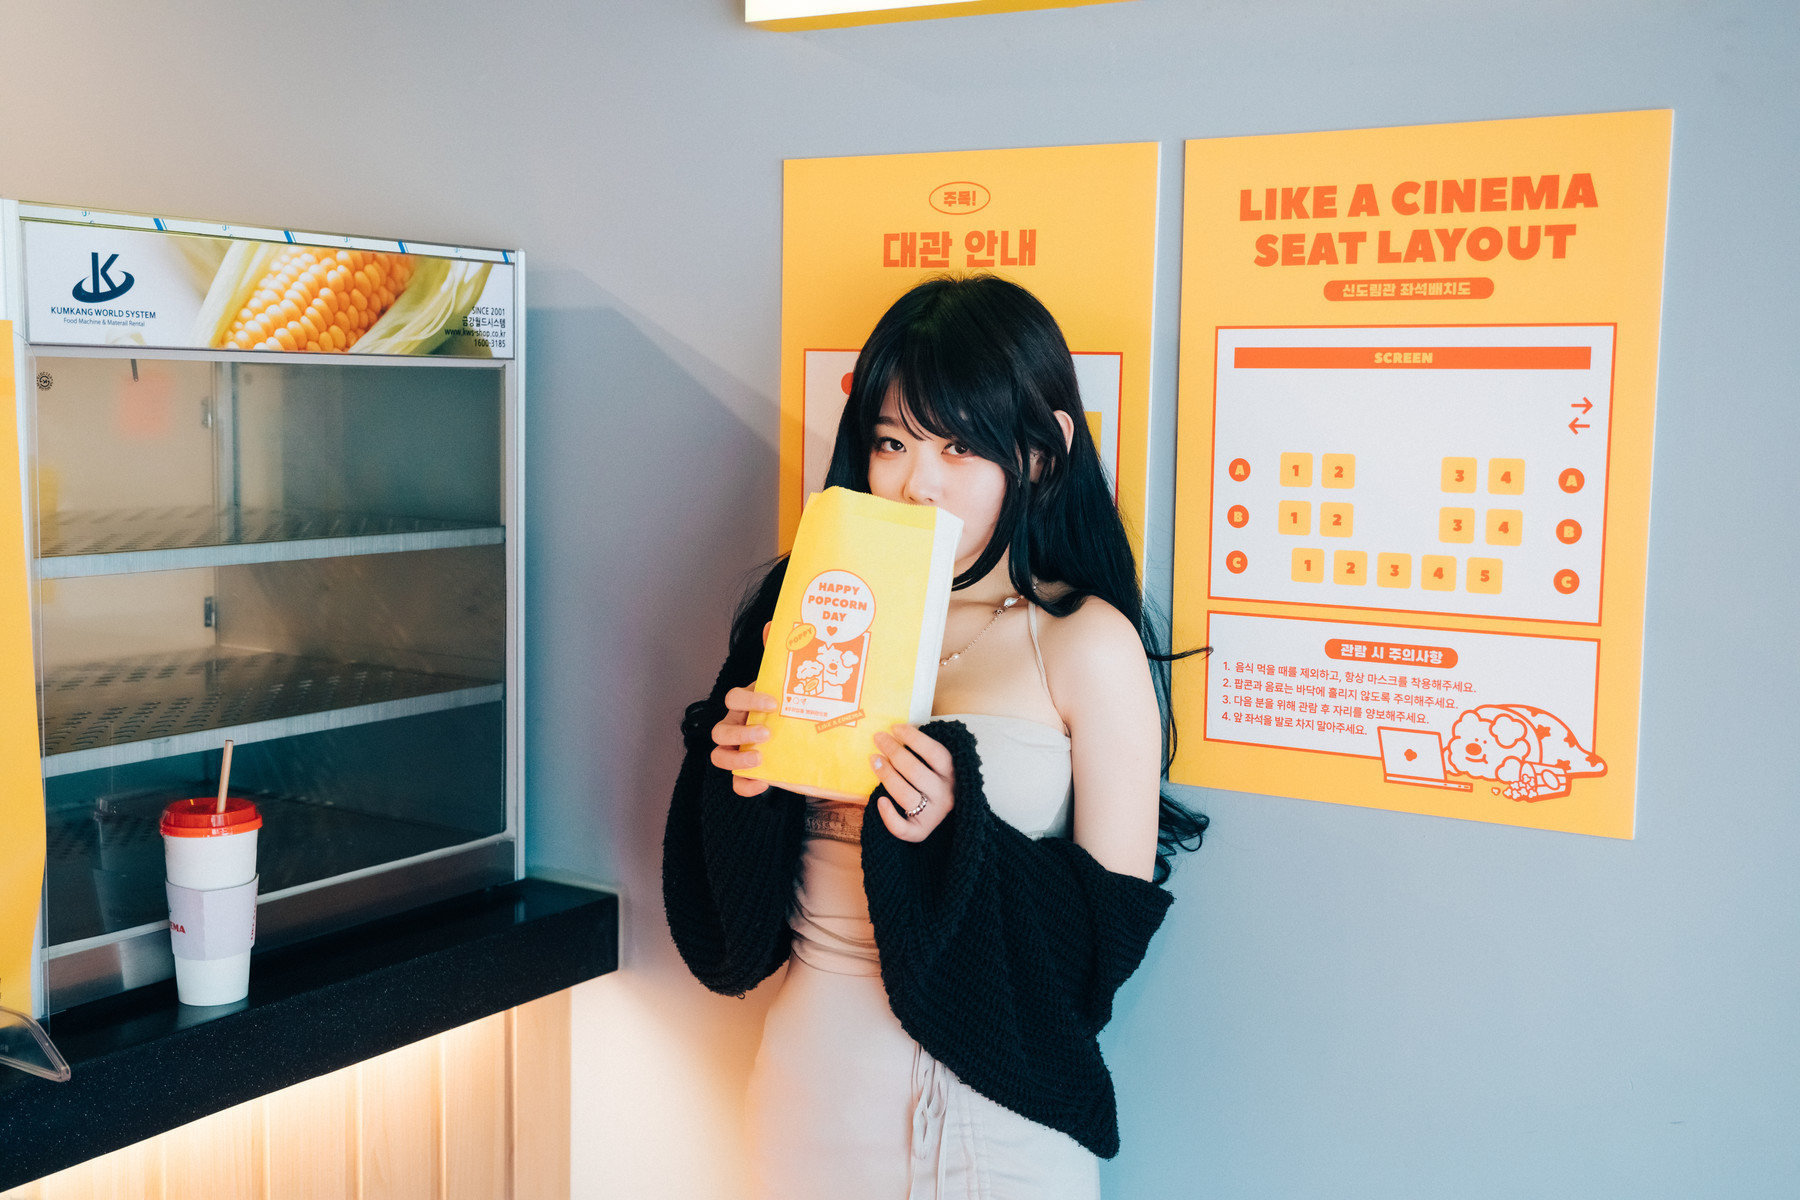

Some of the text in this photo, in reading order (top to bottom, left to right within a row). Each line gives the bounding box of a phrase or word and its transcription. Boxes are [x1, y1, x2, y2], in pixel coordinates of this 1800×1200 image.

[943, 190, 977, 207] 주목!
[1239, 172, 1600, 222] LIKE A CINEMA
[883, 229, 1037, 268] 대관 안내
[1253, 224, 1577, 267] SEAT LAYOUT
[1342, 281, 1471, 298] 신도림관 좌석배치도
[50, 306, 156, 319] KUMKANG WORLD SYSTEM
[472, 306, 505, 316] SINCE 2001
[462, 315, 506, 328] 금강월드시스템
[474, 338, 506, 348] 1600-3185
[1374, 352, 1433, 364] SCREEN
[1235, 464, 1578, 487] A 1 2 3 4 A
[1233, 511, 1575, 538] B 1 2 3 4 B
[1232, 557, 1572, 588] C 1 2 3 4 5 C
[818, 582, 860, 596] HAPPY
[807, 595, 868, 611] POPCORN
[822, 610, 847, 622] DAY
[788, 627, 813, 647] POPPY
[1341, 643, 1443, 664] 관람 시 주의사항
[1223, 661, 1476, 693] 1. 음식 먹을 때를 제외하고, 항상 마스크를 착용해주세요.
[1222, 677, 1458, 709] 2. 팝콘과 음료는 바닥에 흘리지 않도록 주의해주세요.
[1222, 694, 1429, 724] 3. 다음 분을 위해 관람 후 자리를 양보해주세요.
[1221, 711, 1367, 735] 4. 앞 좌석을 발로 차지 말아주세요.
